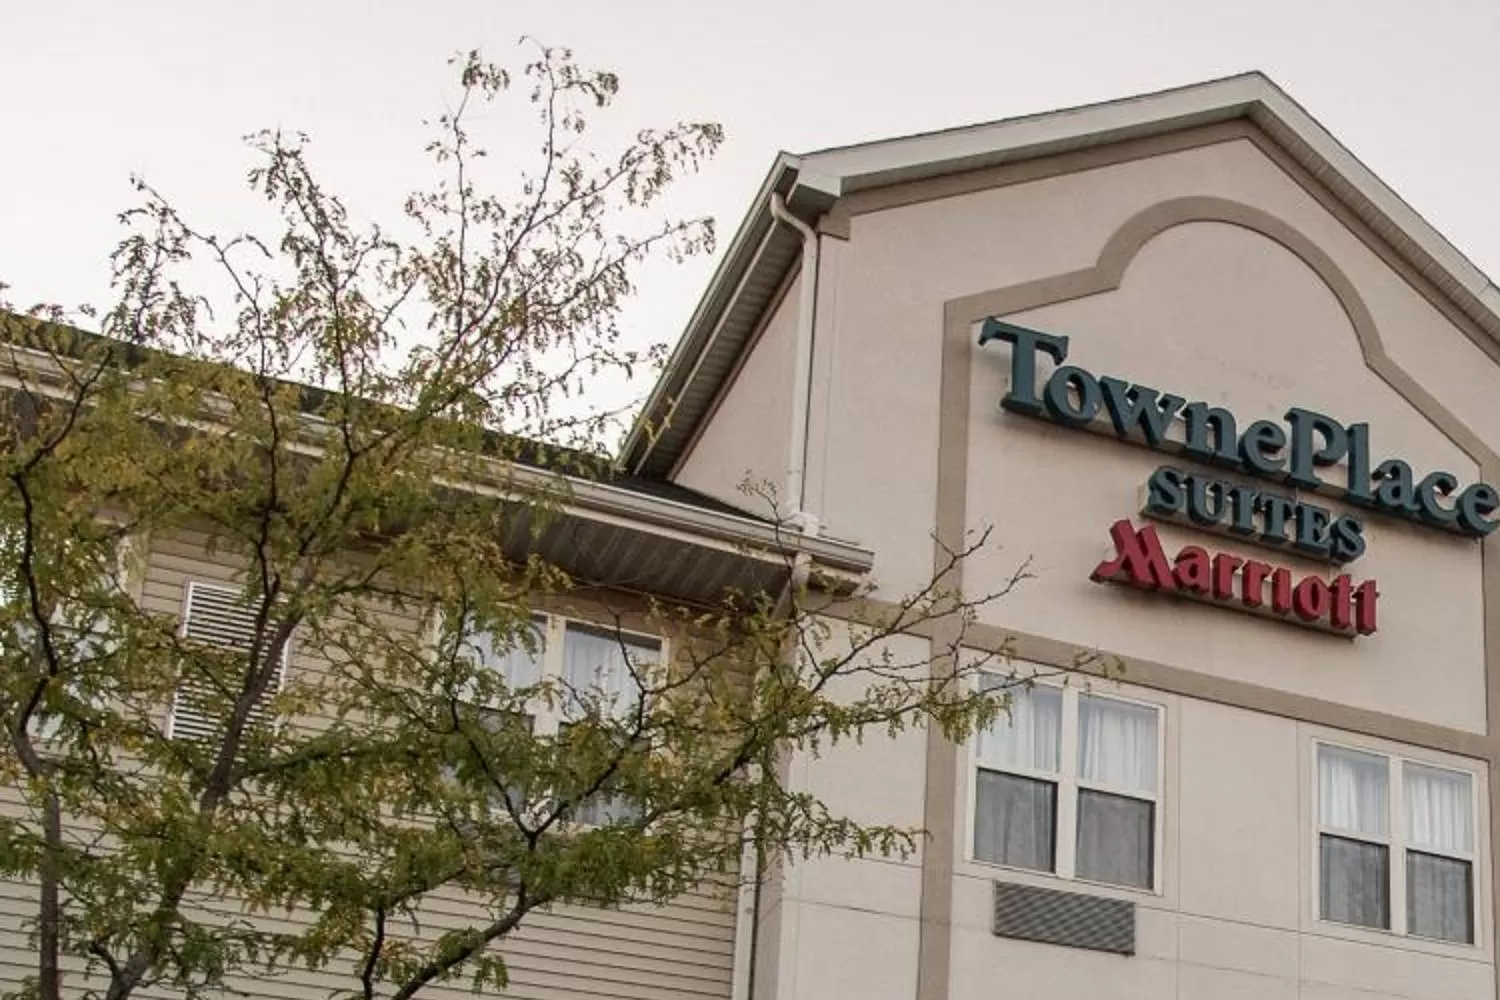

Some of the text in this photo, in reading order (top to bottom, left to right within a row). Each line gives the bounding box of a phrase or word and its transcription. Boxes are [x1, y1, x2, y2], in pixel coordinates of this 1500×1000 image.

[978, 317, 1500, 537] TownePlace
[1146, 465, 1367, 564] SUITES
[1090, 519, 1379, 636] Marriott
